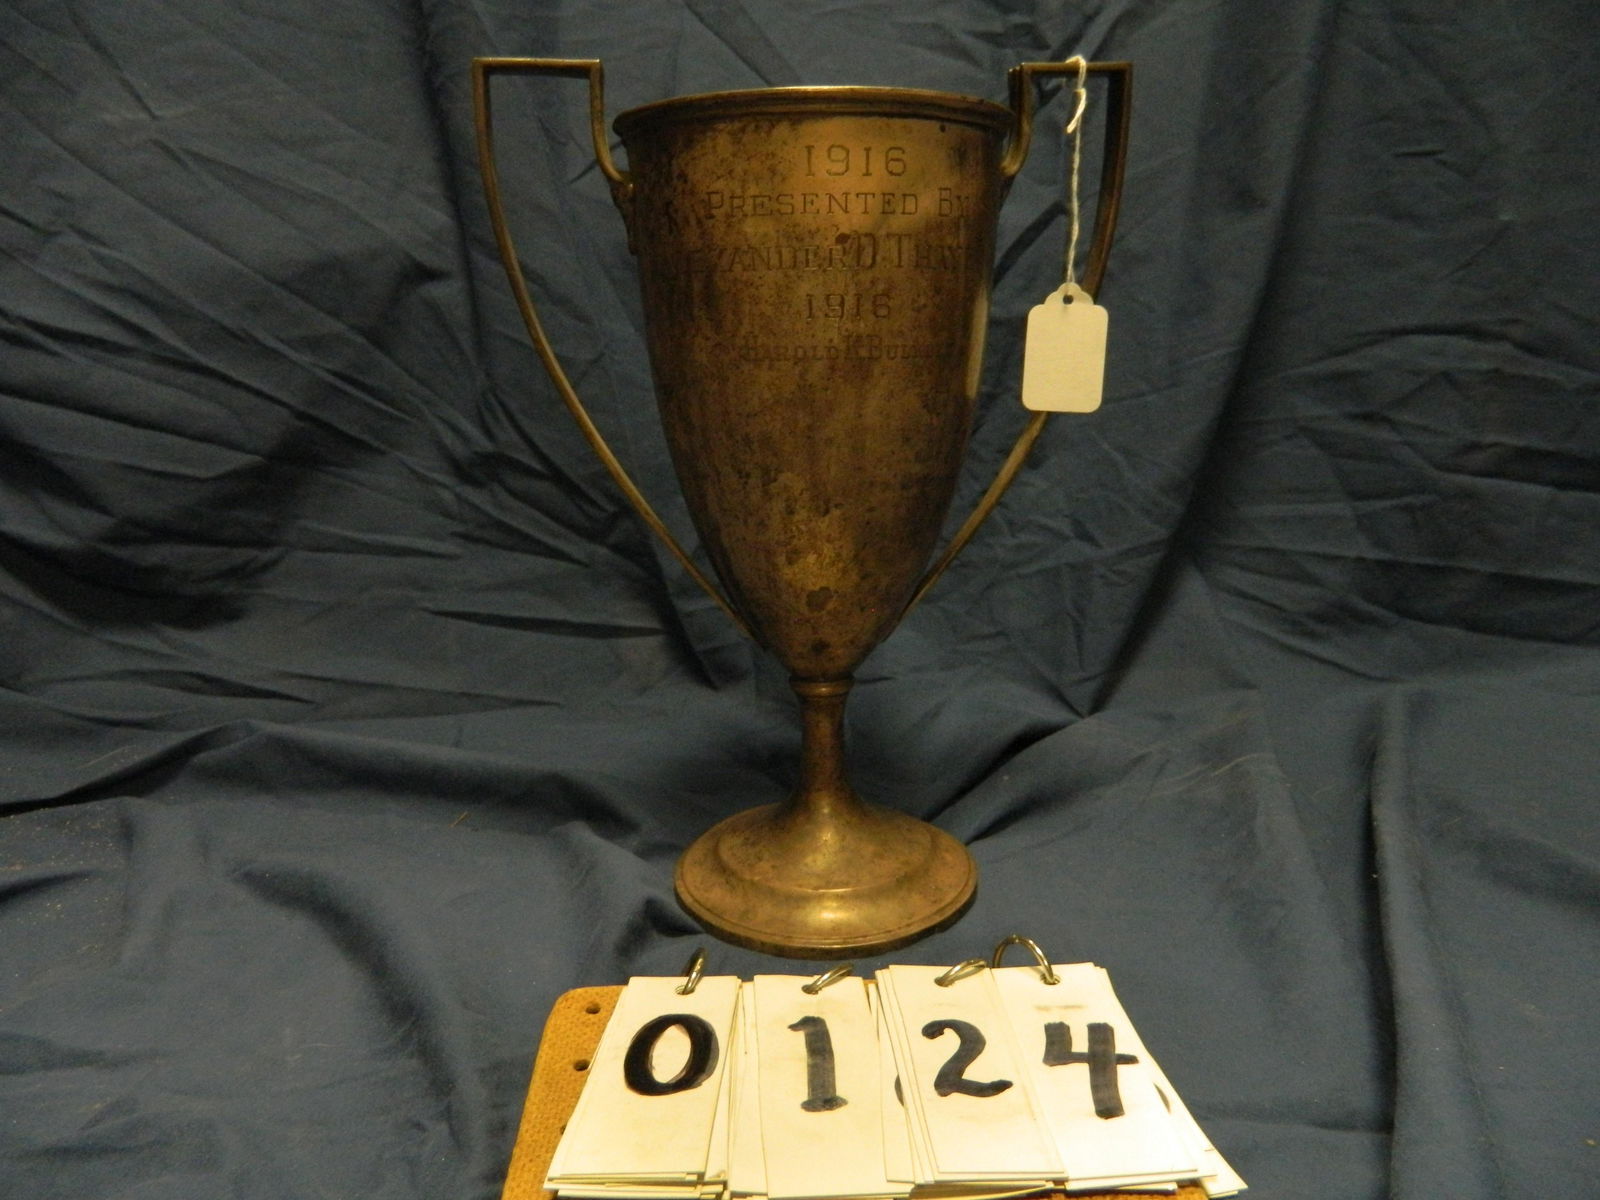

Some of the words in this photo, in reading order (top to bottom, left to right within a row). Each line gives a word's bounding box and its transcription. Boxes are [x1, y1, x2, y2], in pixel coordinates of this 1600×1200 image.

[804, 143, 908, 177] 1916
[704, 191, 919, 219] PRESENTED
[804, 292, 893, 321] 1916
